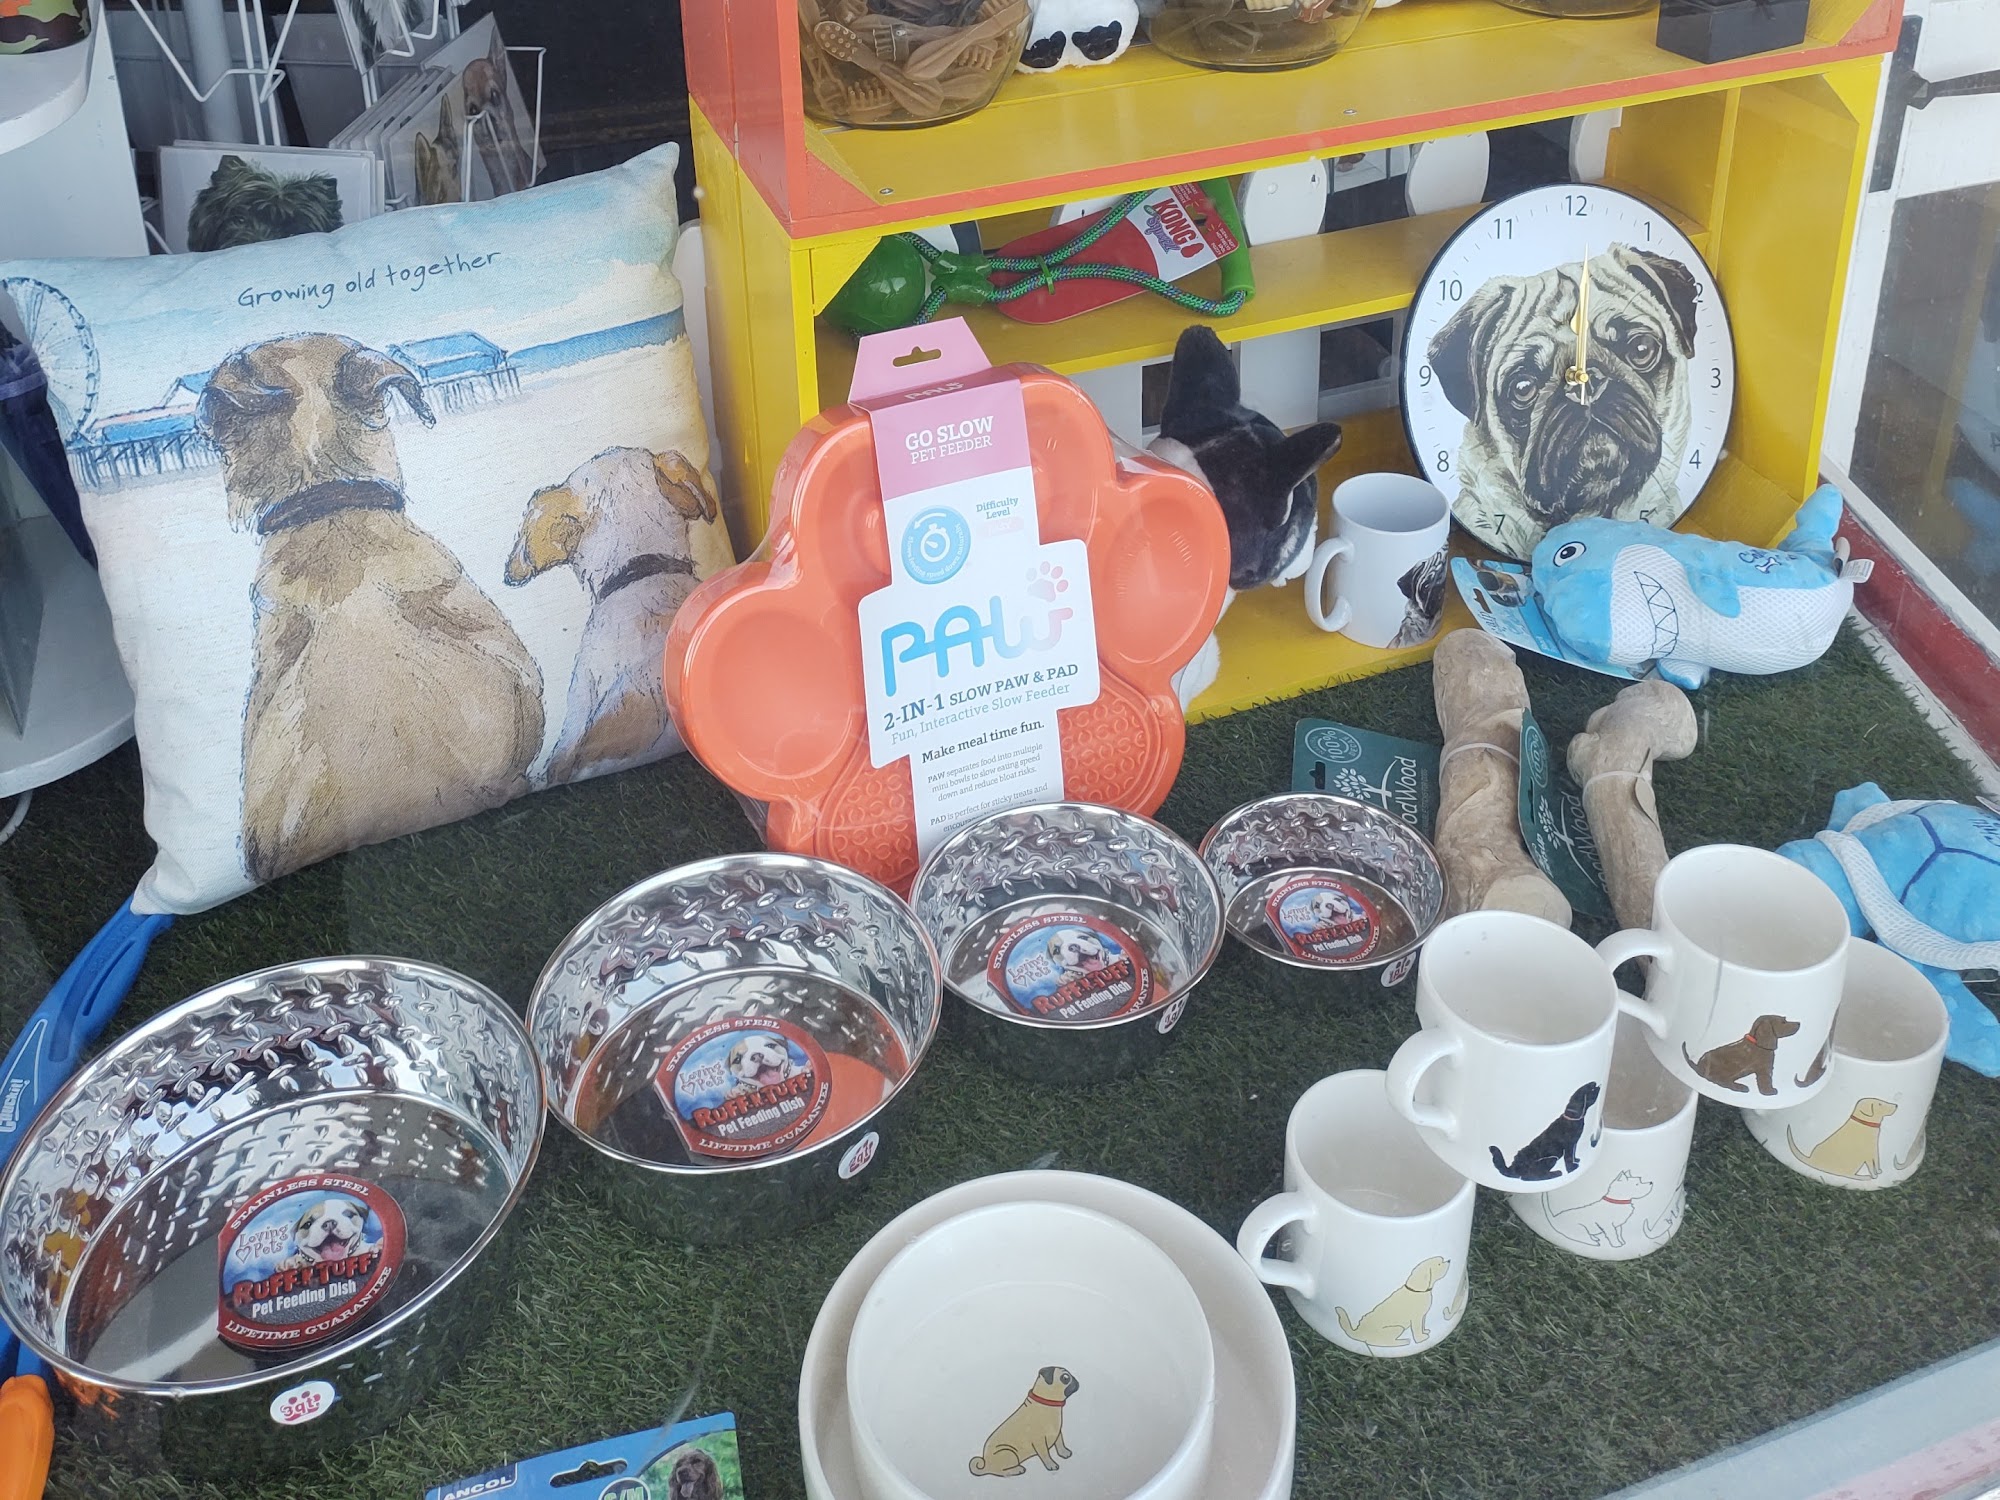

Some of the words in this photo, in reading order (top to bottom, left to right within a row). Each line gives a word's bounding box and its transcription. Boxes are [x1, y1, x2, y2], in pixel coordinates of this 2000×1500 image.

[1565, 195, 1588, 217] 12
[1151, 198, 1197, 246] KONG
[1494, 218, 1514, 240] 11
[1644, 221, 1653, 243] 1
[238, 282, 335, 310] Growing
[345, 268, 376, 293] old
[385, 251, 502, 292] together
[1439, 279, 1463, 302] 10
[1692, 282, 1704, 303] 2
[1419, 365, 1432, 388] 9
[1710, 367, 1722, 388] 3
[905, 429, 933, 451] GO
[937, 415, 994, 444] SLOW
[911, 448, 937, 465] PET
[939, 435, 993, 458] FEEDER
[1436, 451, 1450, 473] 8
[1688, 449, 1702, 470] 4
[976, 497, 1019, 513] Difficulty
[985, 507, 1011, 520] Level
[1494, 514, 1506, 535] 7
[880, 595, 1074, 697] PAW
[883, 693, 945, 732] 2-IN-1
[949, 683, 993, 706] SLOW
[995, 673, 1029, 693] PAW
[1033, 671, 1044, 683] &
[1046, 664, 1079, 681] PAD
[891, 728, 918, 745] Fun,
[920, 704, 989, 733] Interactive
[991, 695, 1023, 711] Slow
[1025, 683, 1070, 702] Feeder
[921, 745, 956, 764] Make
[958, 732, 988, 752] meal
[989, 726, 1018, 742] time
[1020, 720, 1045, 733] fun.
[1321, 730, 1345, 760] 100%
[927, 771, 945, 783] PAW
[946, 760, 980, 779] separates
[980, 754, 997, 767] food
[997, 750, 1012, 762] into
[1013, 742, 1043, 760] multiple
[932, 782, 949, 793] mini
[949, 773, 971, 787] bowls
[971, 771, 979, 781] to
[979, 766, 996, 778] slow
[1020, 753, 1041, 767] speed
[938, 790, 959, 802] down
[960, 782, 974, 795] and
[974, 775, 999, 792] reduce
[1000, 769, 1018, 783] bloat
[1395, 756, 1418, 825] odWood
[930, 815, 947, 826] PAD
[948, 812, 954, 821] is
[954, 804, 980, 820] perfect
[980, 799, 991, 810] for
[992, 793, 1012, 808] sticky
[1013, 787, 1033, 801] treats
[1034, 782, 1048, 795] and
[1311, 880, 1342, 890] STEEL
[992, 919, 1040, 969] STAINLESS
[1043, 914, 1087, 924] STEEL
[1007, 953, 1050, 979] Loving
[1027, 966, 1051, 982] Pets
[1059, 1004, 1077, 1019] Pet
[1075, 991, 1113, 1014] Feeding
[1109, 980, 1132, 1000] Dish
[666, 1022, 731, 1072] STAINLESS
[734, 1018, 781, 1030] STEEL
[678, 1061, 726, 1085] Loving
[698, 1075, 725, 1093] Pets
[698, 1138, 773, 1151] LIFETIME
[774, 1081, 829, 1145] GUARANTEE
[717, 1119, 739, 1137] Pet
[739, 1106, 781, 1130] Feeding
[780, 1095, 806, 1114] Dish
[230, 1178, 318, 1230] STAINLESS
[322, 1178, 370, 1196] STEEL
[238, 1223, 290, 1249] Loving
[254, 1240, 283, 1259] Pets
[225, 1319, 301, 1340] LIFETIME
[304, 1266, 393, 1336] GUARANTEE
[252, 1300, 274, 1319] Pet
[276, 1287, 326, 1312] Feeding
[329, 1279, 357, 1298] Dish
[444, 1476, 512, 1500] ANCOL
